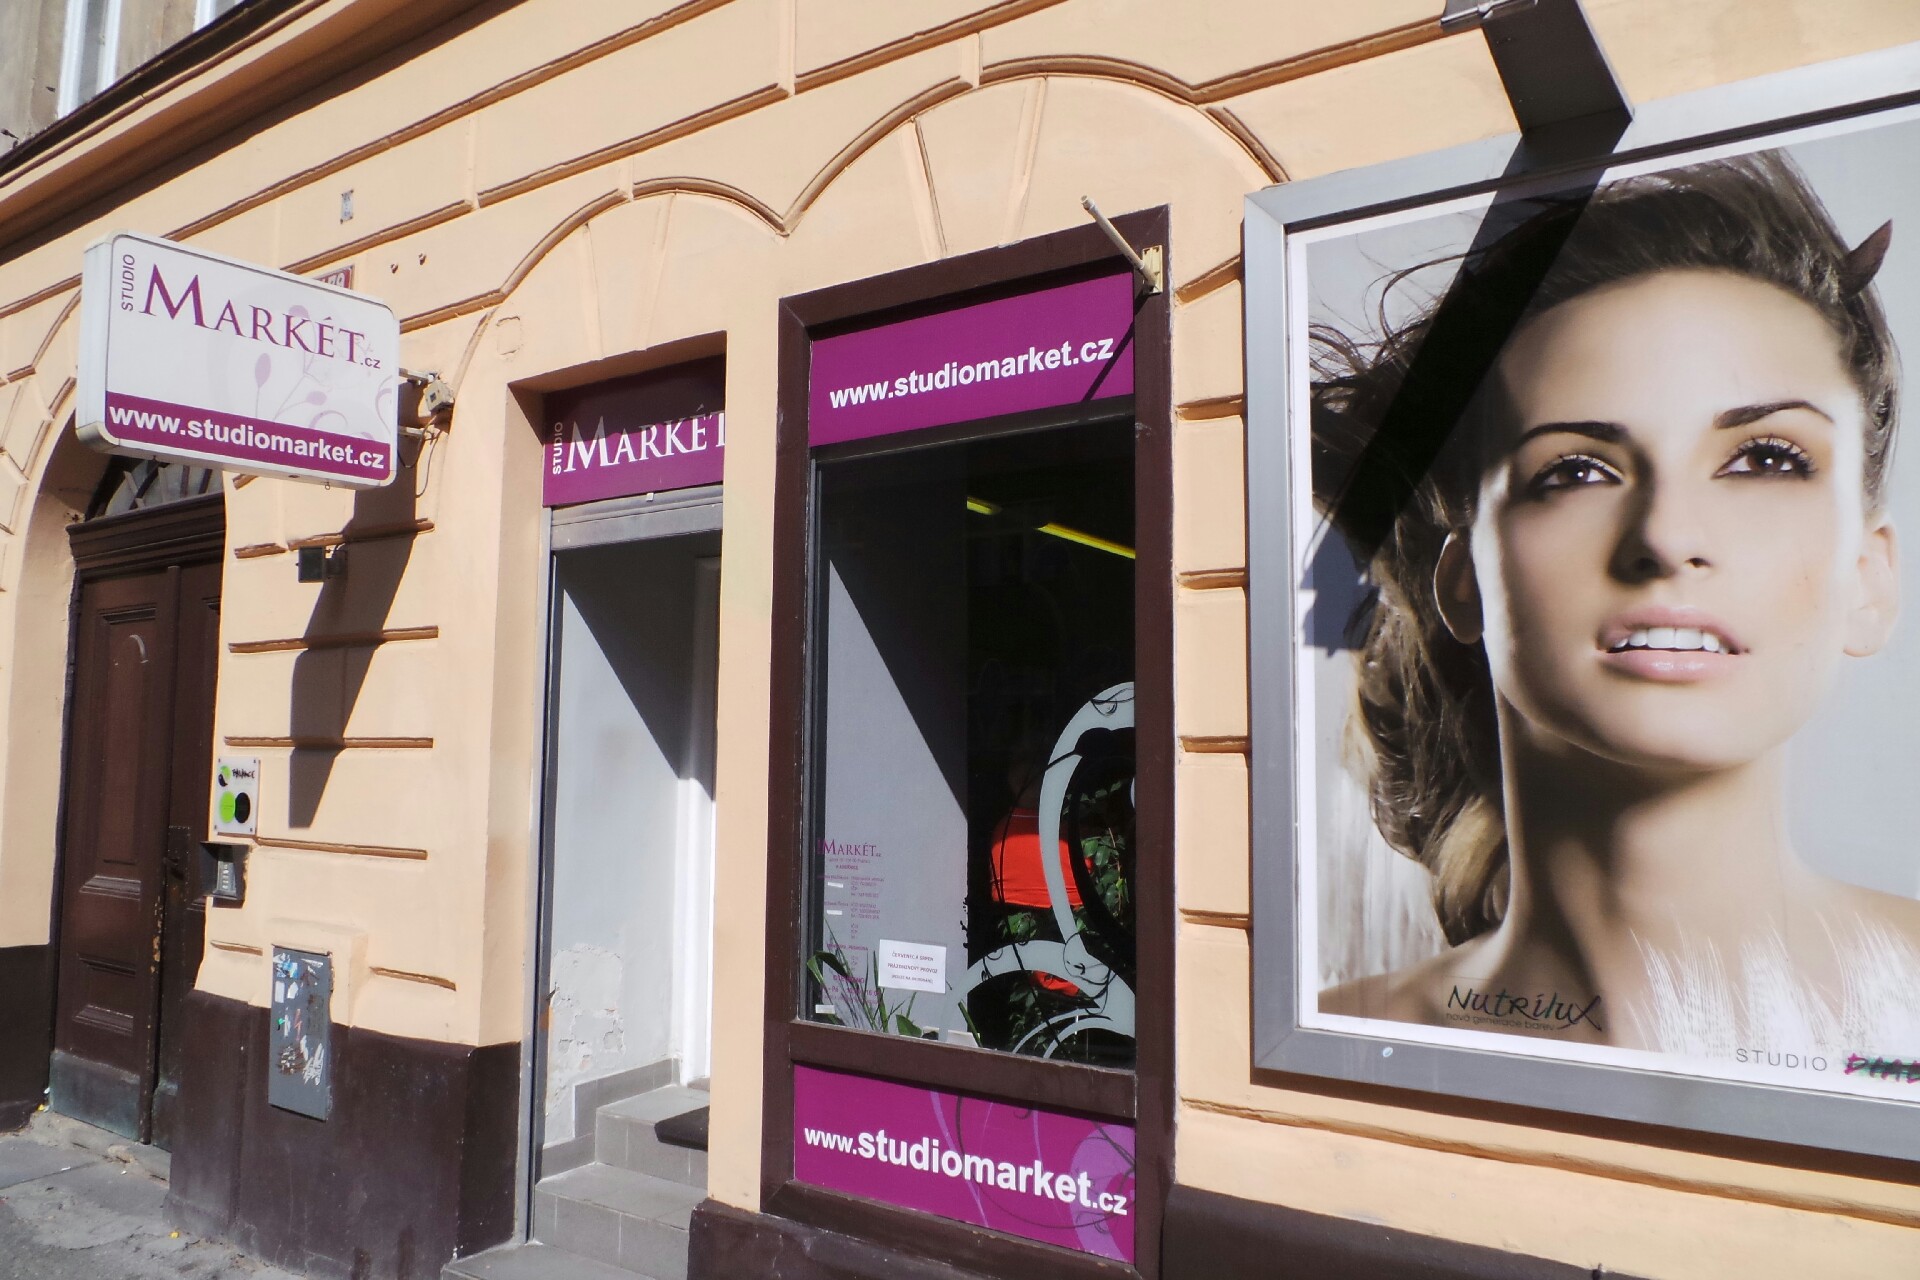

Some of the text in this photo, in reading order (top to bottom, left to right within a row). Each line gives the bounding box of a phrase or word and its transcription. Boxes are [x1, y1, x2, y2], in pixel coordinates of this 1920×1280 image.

[122, 254, 135, 312] STUDIO
[829, 337, 1114, 409] www.studiomarket.cz
[109, 406, 385, 469] www.studiomarket.cz
[552, 421, 563, 475] STUDIO
[1735, 1047, 1828, 1073] STUDIO
[804, 1127, 1128, 1216] www.studiomarket.cz
